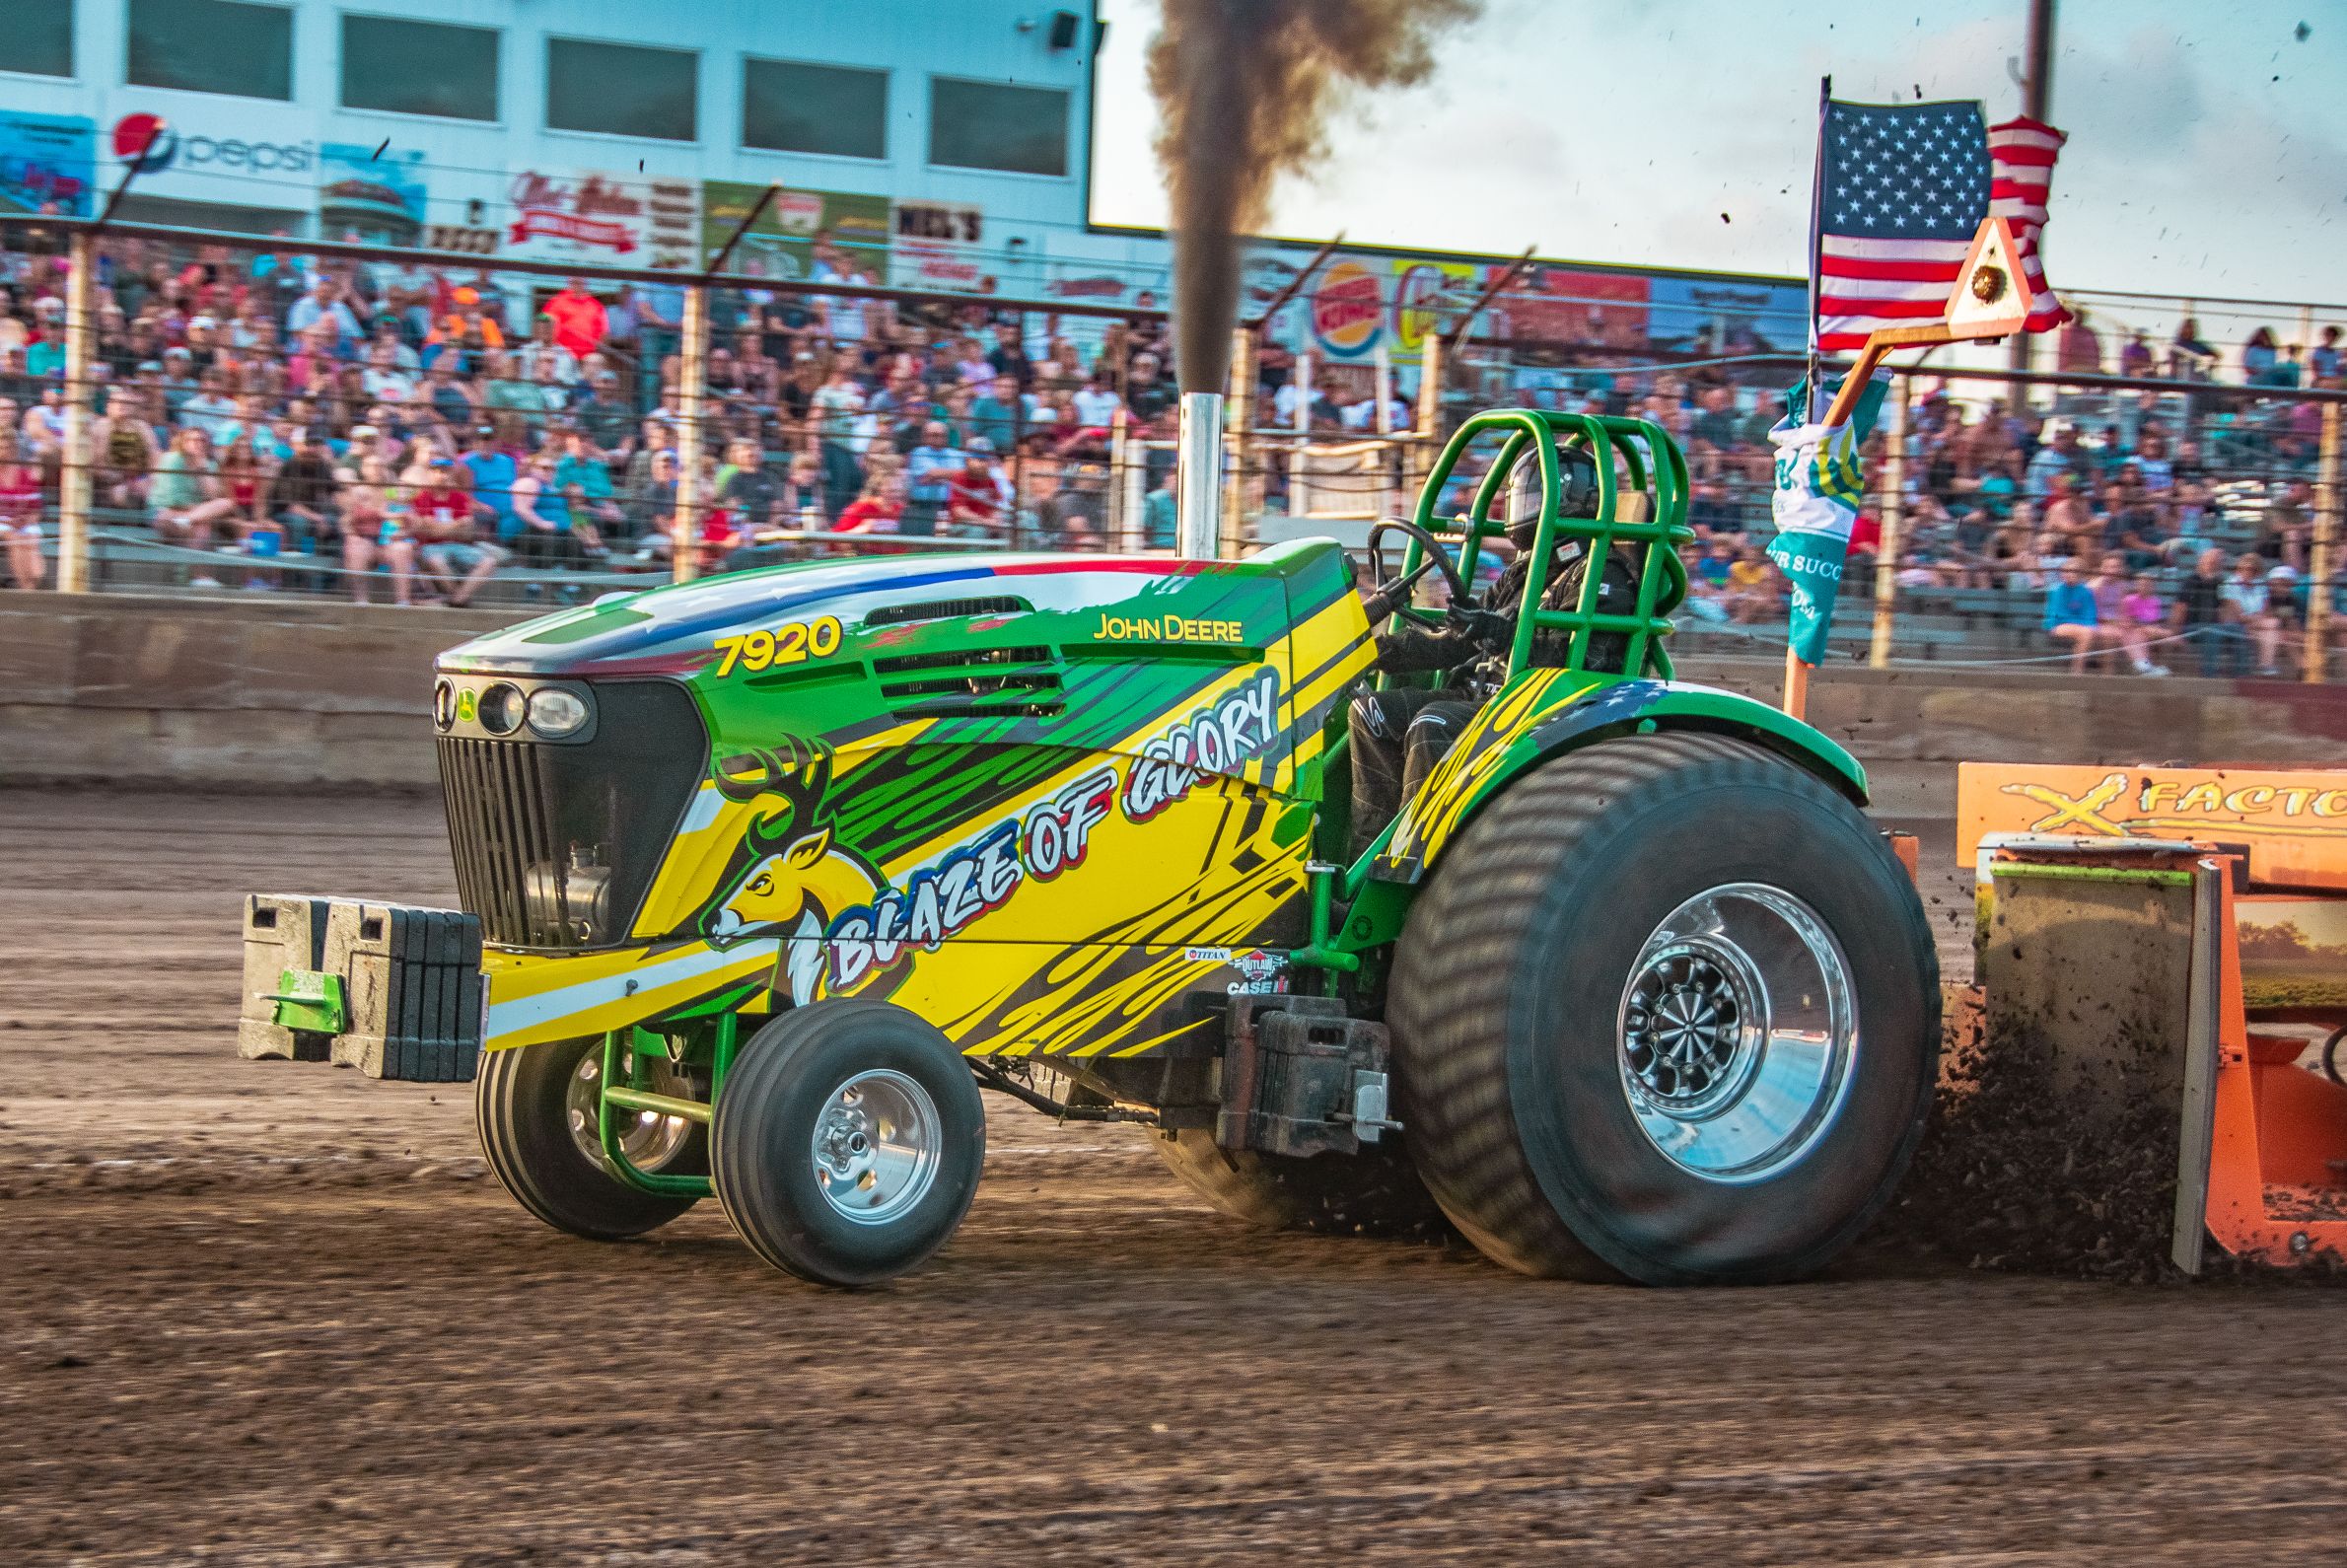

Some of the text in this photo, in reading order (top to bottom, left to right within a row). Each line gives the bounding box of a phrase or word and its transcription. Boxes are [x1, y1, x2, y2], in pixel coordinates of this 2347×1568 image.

[184, 135, 314, 174] pepsi
[1164, 613, 1244, 642] DEERE
[714, 615, 843, 678] 7920
[2000, 772, 2130, 838] X
[829, 676, 1273, 989] BLAZE OF GLORY
[1196, 950, 1227, 960] TITAN
[1243, 957, 1273, 972] OUTLAW
[1227, 980, 1272, 996] CASE
